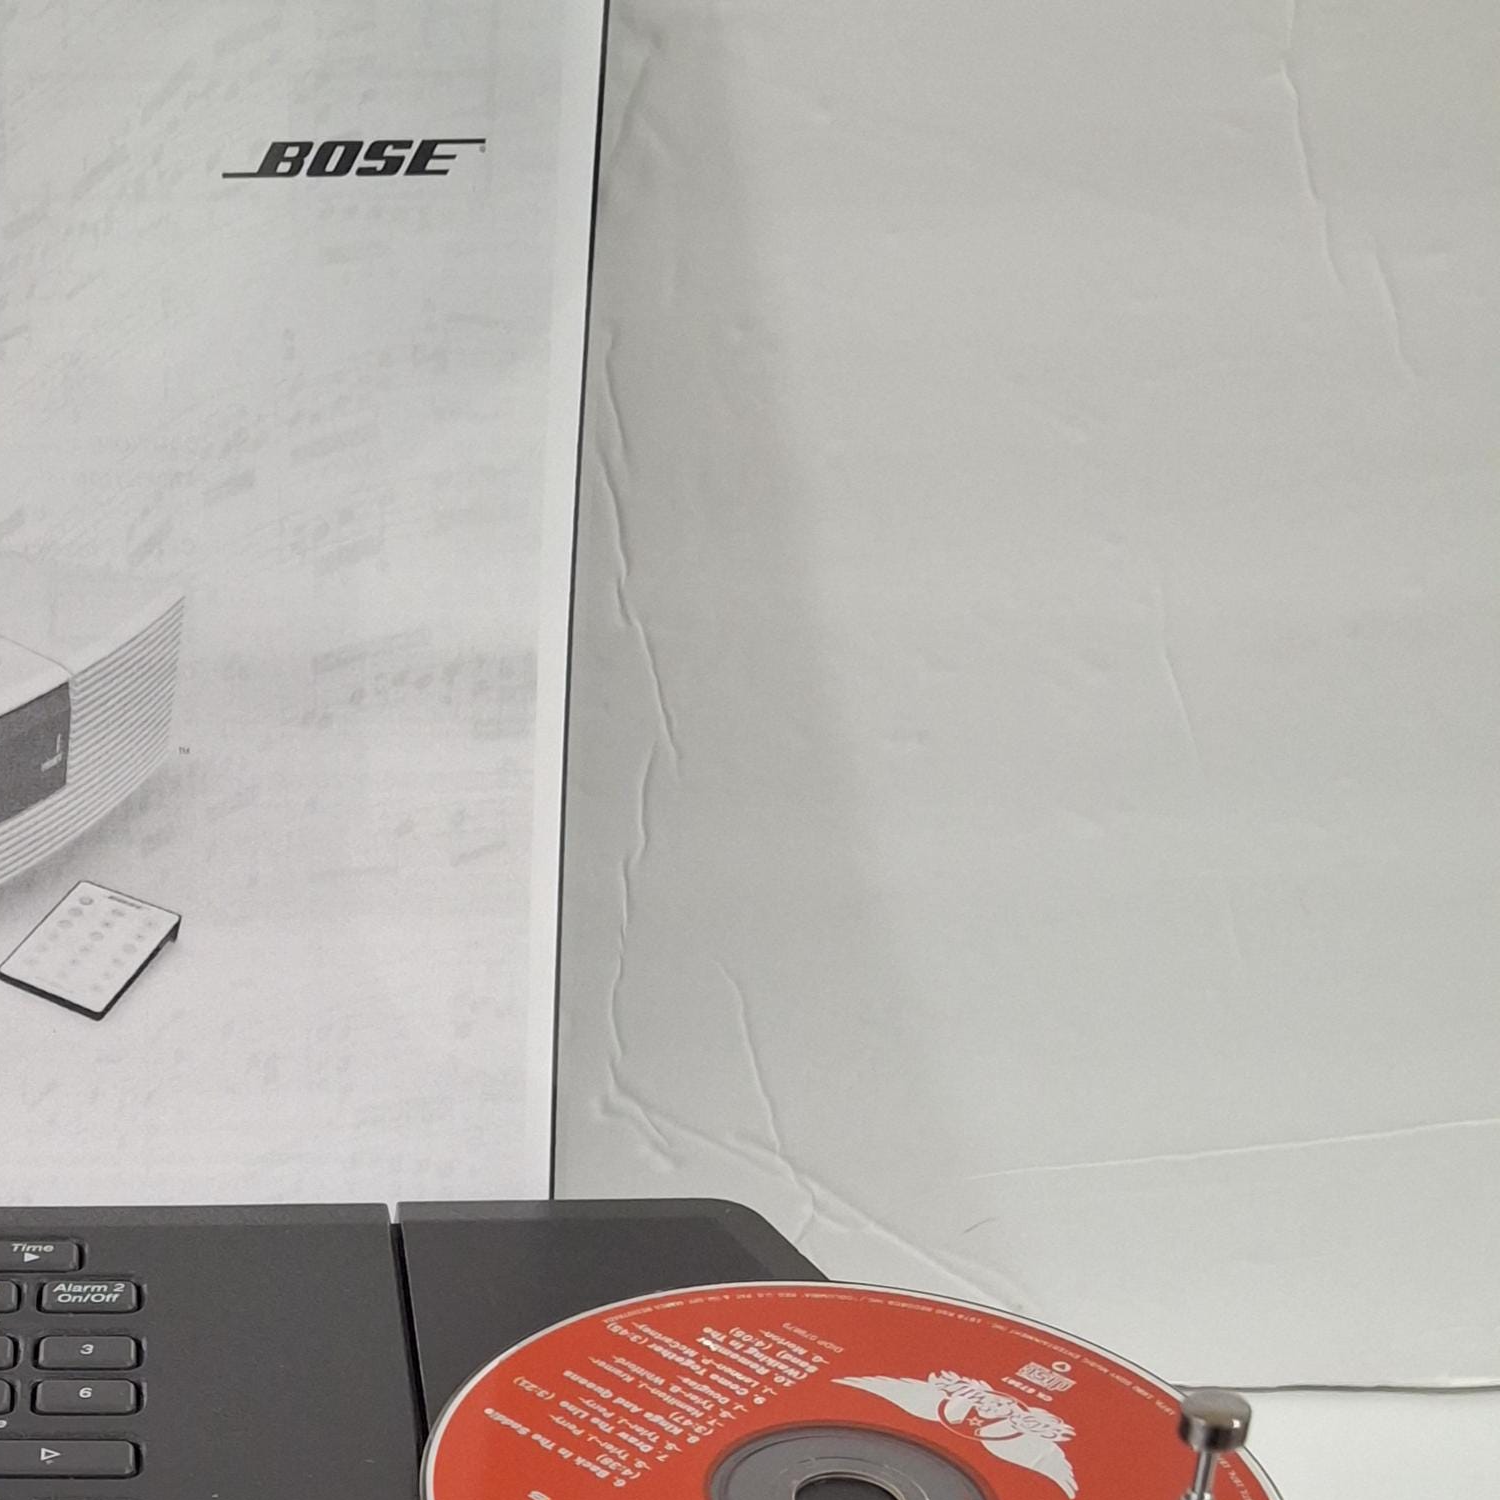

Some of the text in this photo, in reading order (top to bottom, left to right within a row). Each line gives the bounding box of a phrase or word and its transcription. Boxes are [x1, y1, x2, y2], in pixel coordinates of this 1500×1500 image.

[222, 138, 486, 178] BOSE
[11, 1243, 54, 1253] Time
[53, 1282, 125, 1293] Alarm 2
[57, 1292, 119, 1304] On/Off
[80, 1344, 94, 1355] 3
[702, 1326, 807, 1379] (Walking In The
[647, 1343, 706, 1376] Together
[696, 1336, 794, 1386] 10. Remember
[79, 1387, 92, 1398] 6
[563, 1370, 613, 1398] Queens
[709, 1373, 748, 1395] Come
[612, 1396, 642, 1412] And
[753, 1394, 765, 1404] 9.
[559, 1400, 589, 1418] Line
[483, 1407, 530, 1434] Saddle
[590, 1416, 614, 1433] The
[643, 1411, 683, 1435] Kings
[531, 1433, 555, 1450] The
[616, 1431, 653, 1452] Draw
[557, 1447, 573, 1458] In
[655, 1450, 668, 1461] 7.
[574, 1456, 610, 1478] Back
